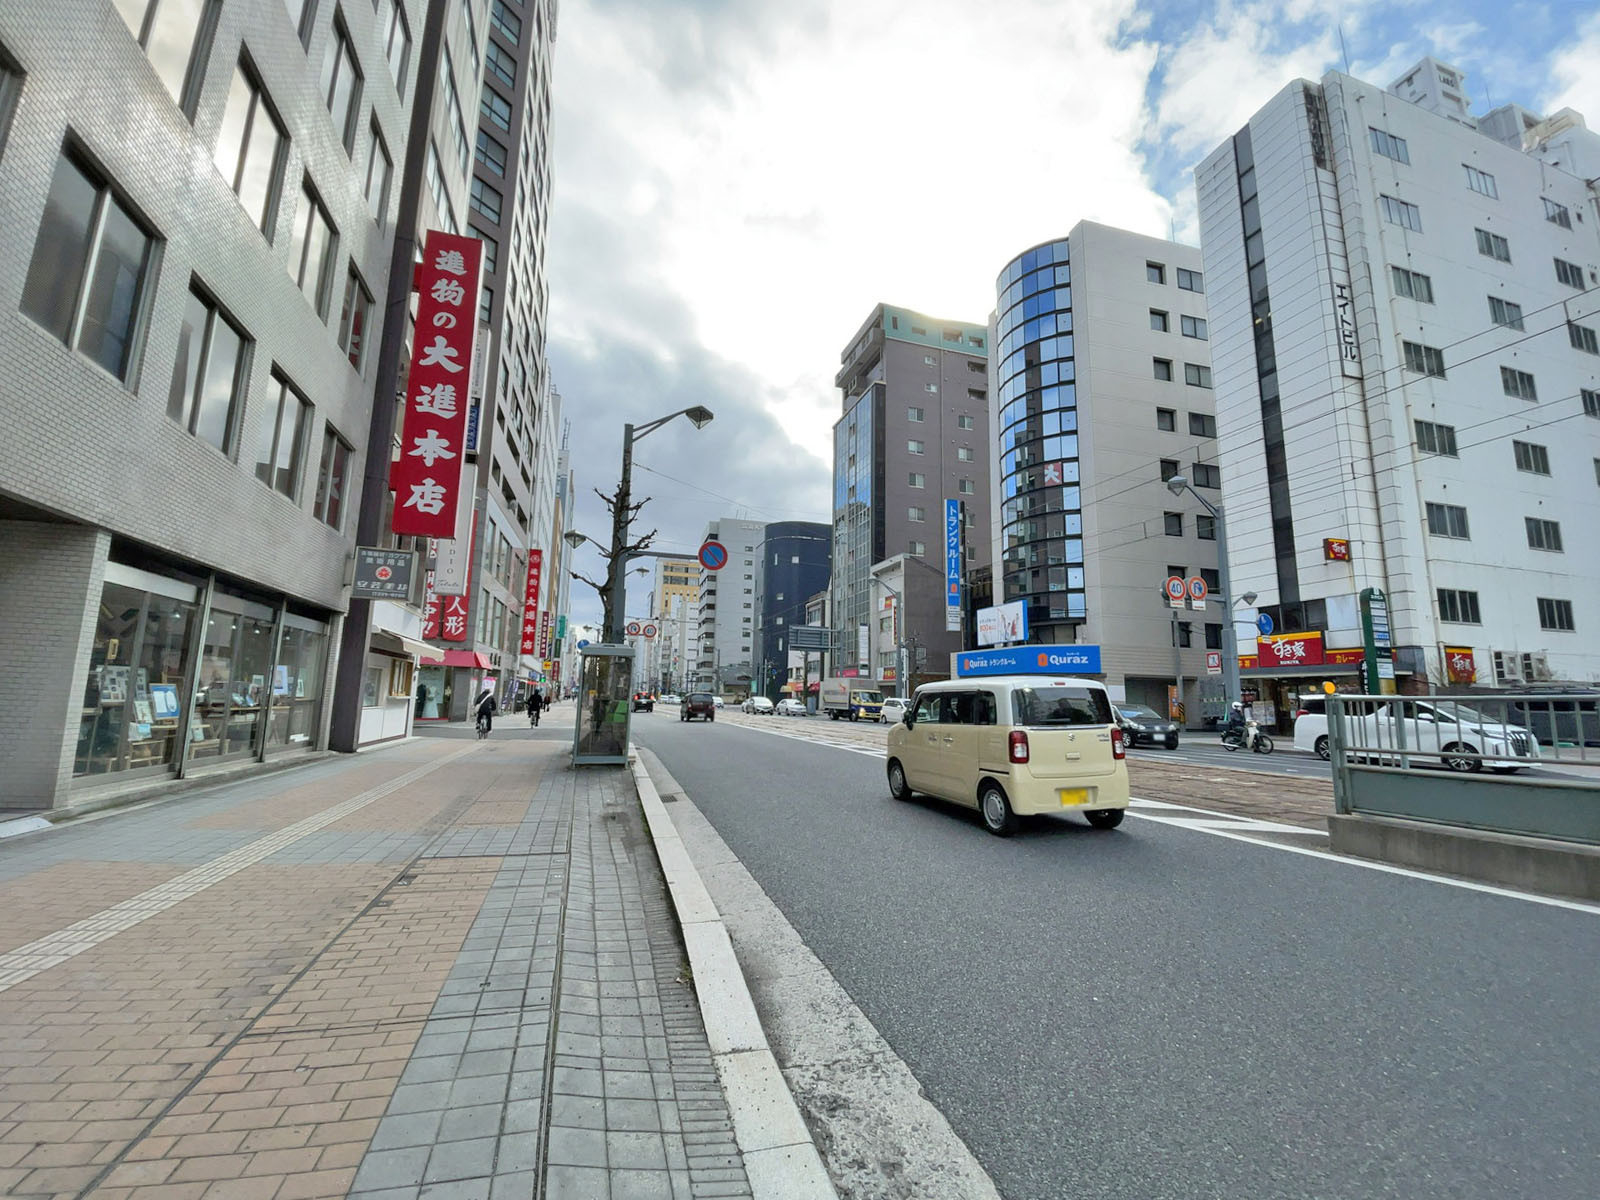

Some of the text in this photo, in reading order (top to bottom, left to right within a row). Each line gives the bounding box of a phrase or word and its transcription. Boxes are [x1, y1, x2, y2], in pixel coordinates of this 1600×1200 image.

[1336, 284, 1357, 361] エイトビル
[403, 249, 469, 515] 進物の大進本店
[948, 505, 958, 579] トランクルーム
[1171, 583, 1182, 594] 40
[445, 596, 467, 636] 人形
[522, 568, 539, 649] 進物の大進本店
[1049, 655, 1088, 665] Quraz
[1271, 638, 1306, 659] すき家
[1335, 655, 1355, 663] カレー
[969, 660, 988, 668] Quraz
